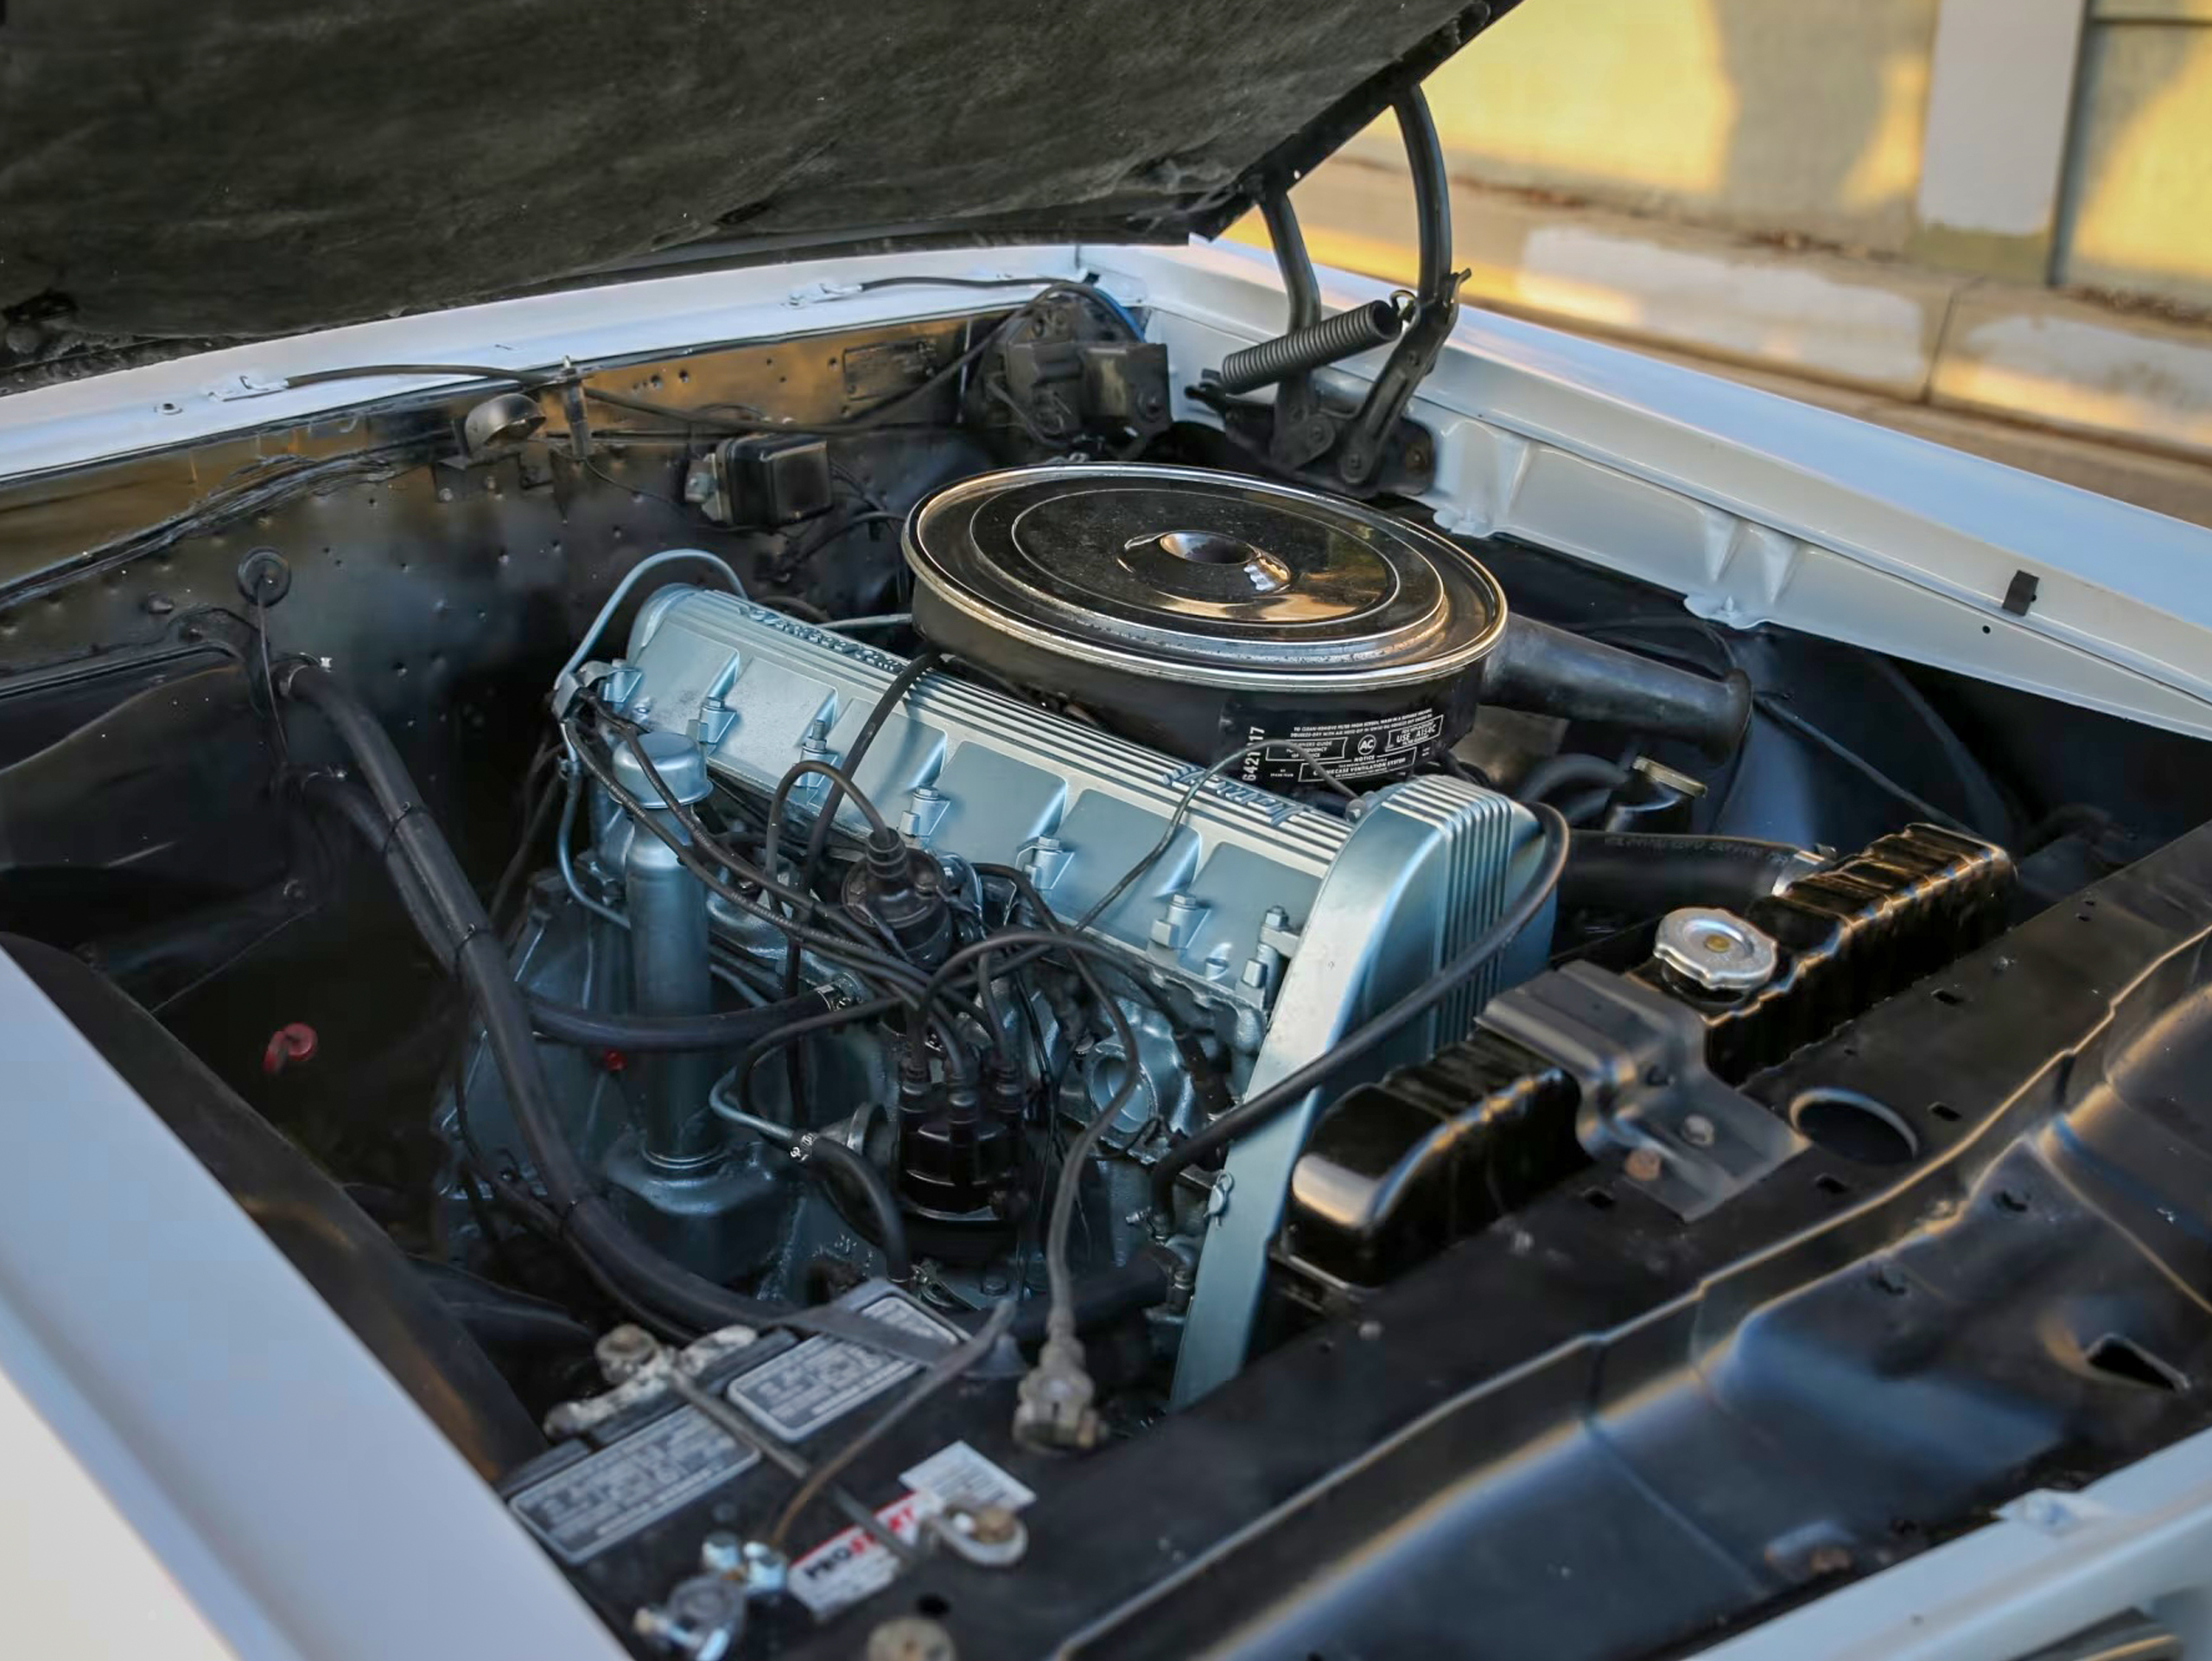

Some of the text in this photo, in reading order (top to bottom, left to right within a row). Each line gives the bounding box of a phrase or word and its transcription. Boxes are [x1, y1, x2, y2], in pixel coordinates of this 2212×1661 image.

[1396, 733, 1411, 743] USE
[1359, 739, 1374, 750] AC
[1242, 726, 1264, 781] 642117
